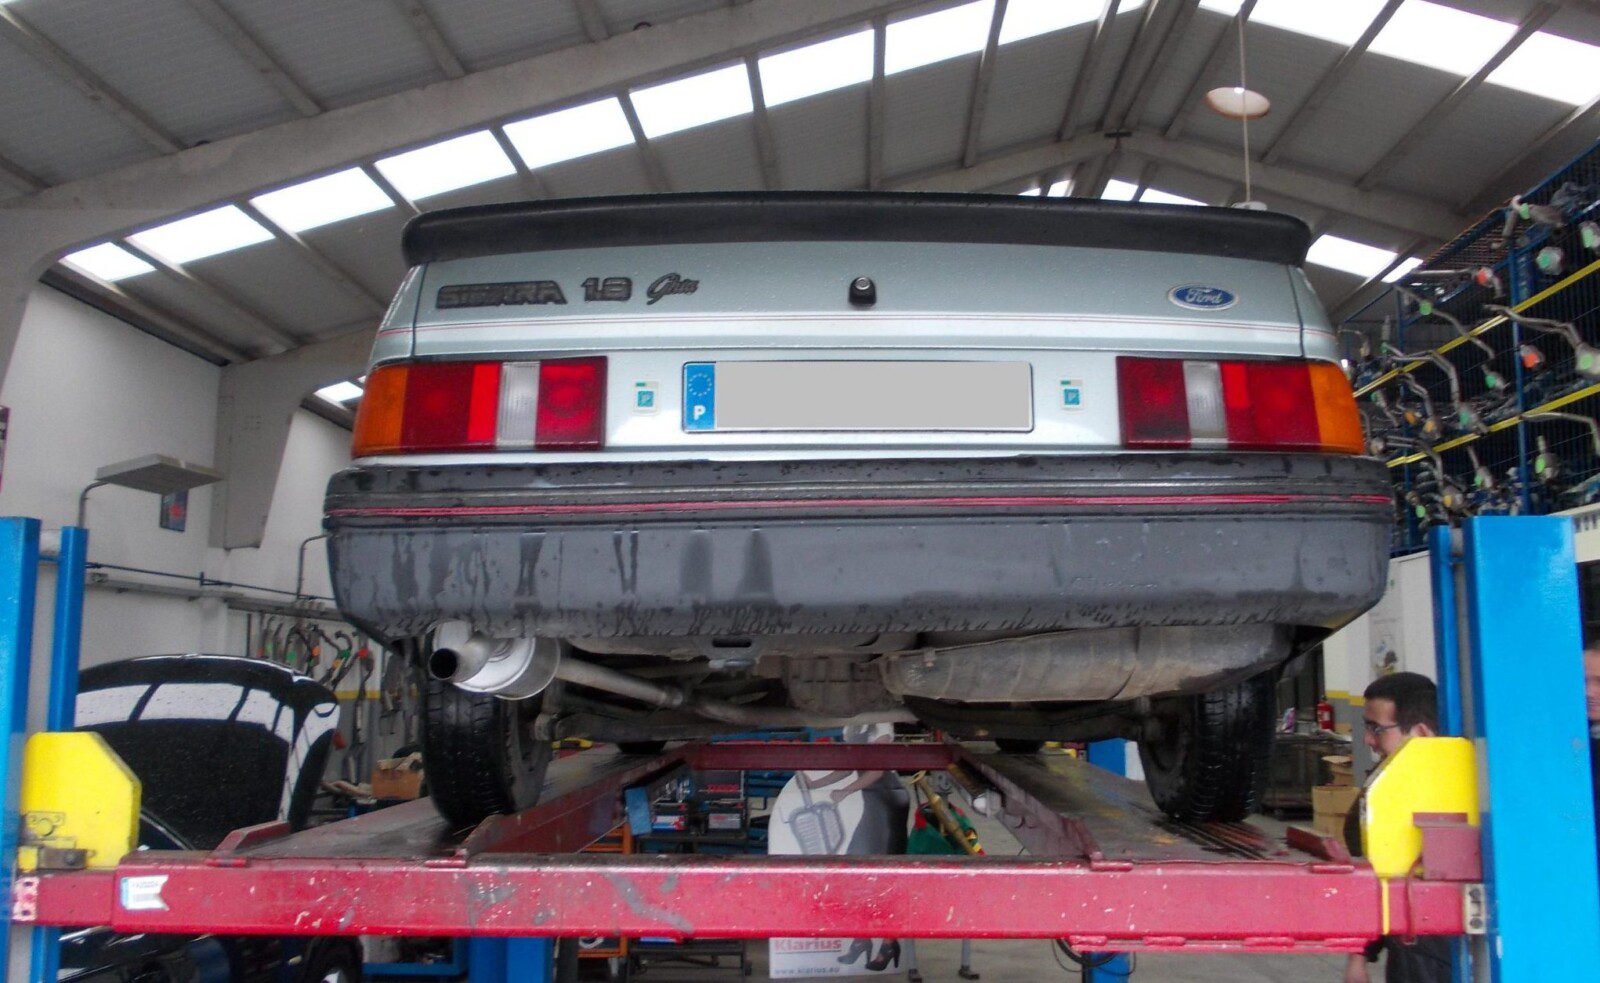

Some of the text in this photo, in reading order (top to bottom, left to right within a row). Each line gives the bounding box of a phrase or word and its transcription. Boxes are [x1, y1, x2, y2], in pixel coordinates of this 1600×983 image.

[1185, 286, 1222, 304] Ford
[693, 404, 707, 421] P
[776, 938, 842, 951] Klarius
